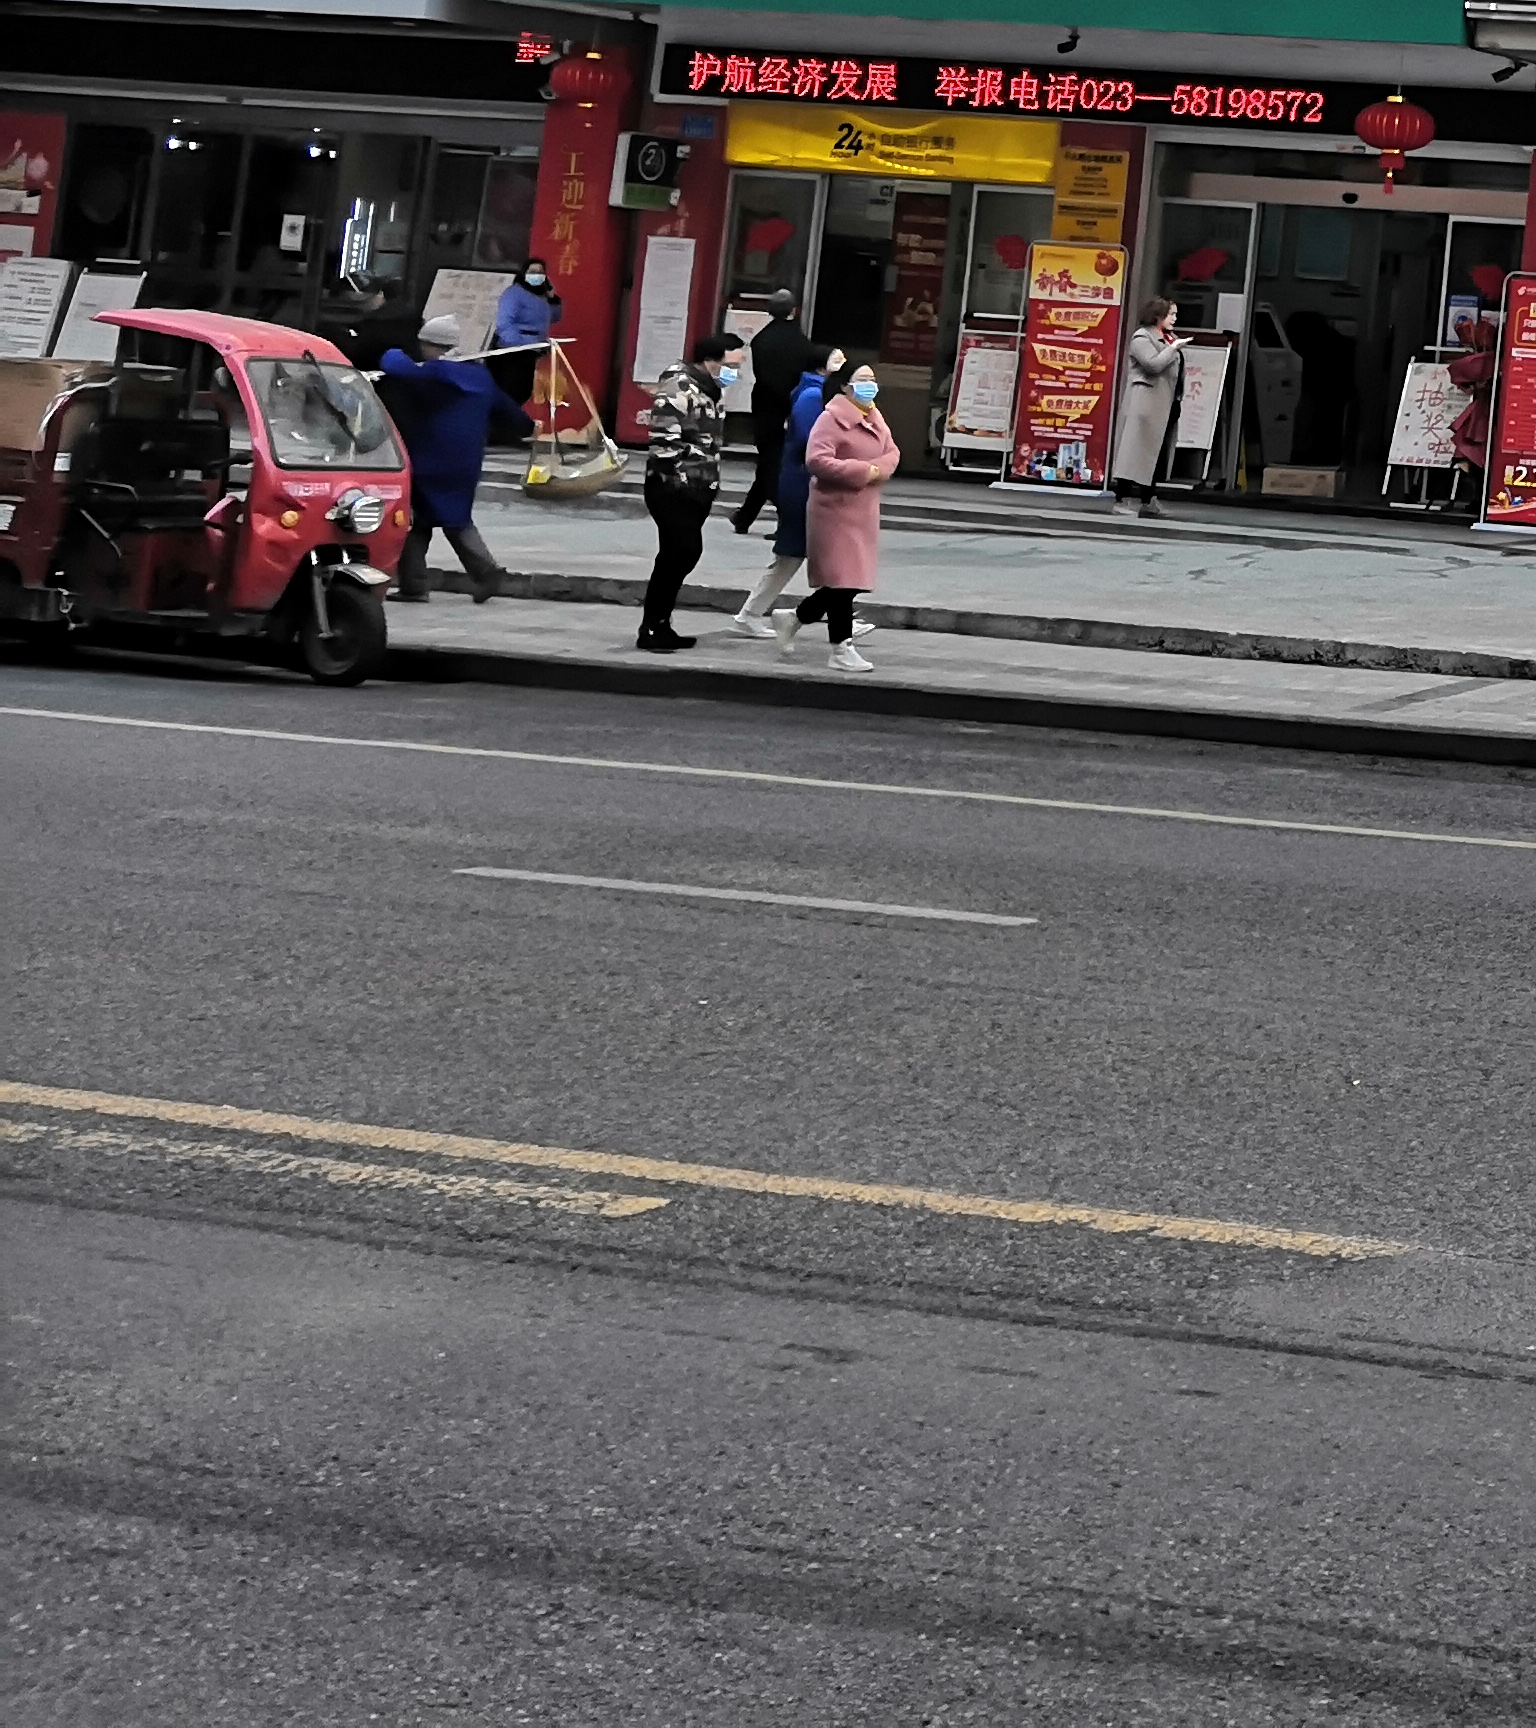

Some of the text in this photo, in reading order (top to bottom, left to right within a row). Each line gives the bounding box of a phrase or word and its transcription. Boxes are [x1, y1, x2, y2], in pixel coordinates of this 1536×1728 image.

[688, 50, 898, 102] 护航经济发展
[833, 122, 864, 157] 24
